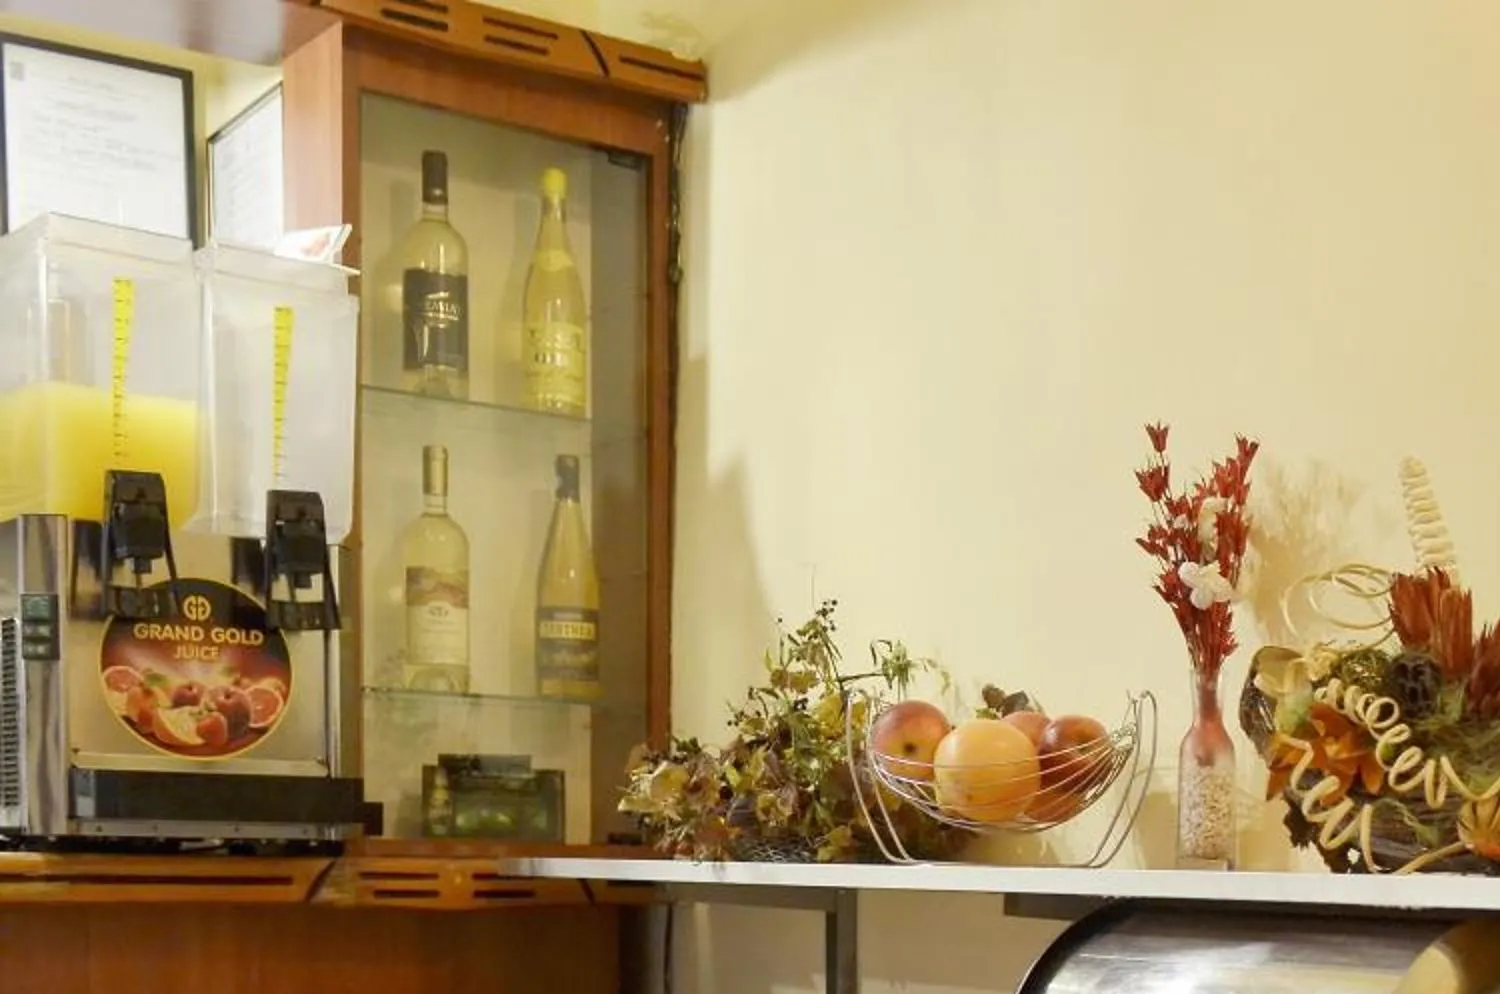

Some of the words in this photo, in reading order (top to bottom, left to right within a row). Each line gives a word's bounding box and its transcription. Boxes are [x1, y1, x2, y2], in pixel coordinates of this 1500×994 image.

[133, 623, 205, 643] GRAND
[211, 627, 264, 646] GOLD
[174, 645, 220, 661] JUICE
